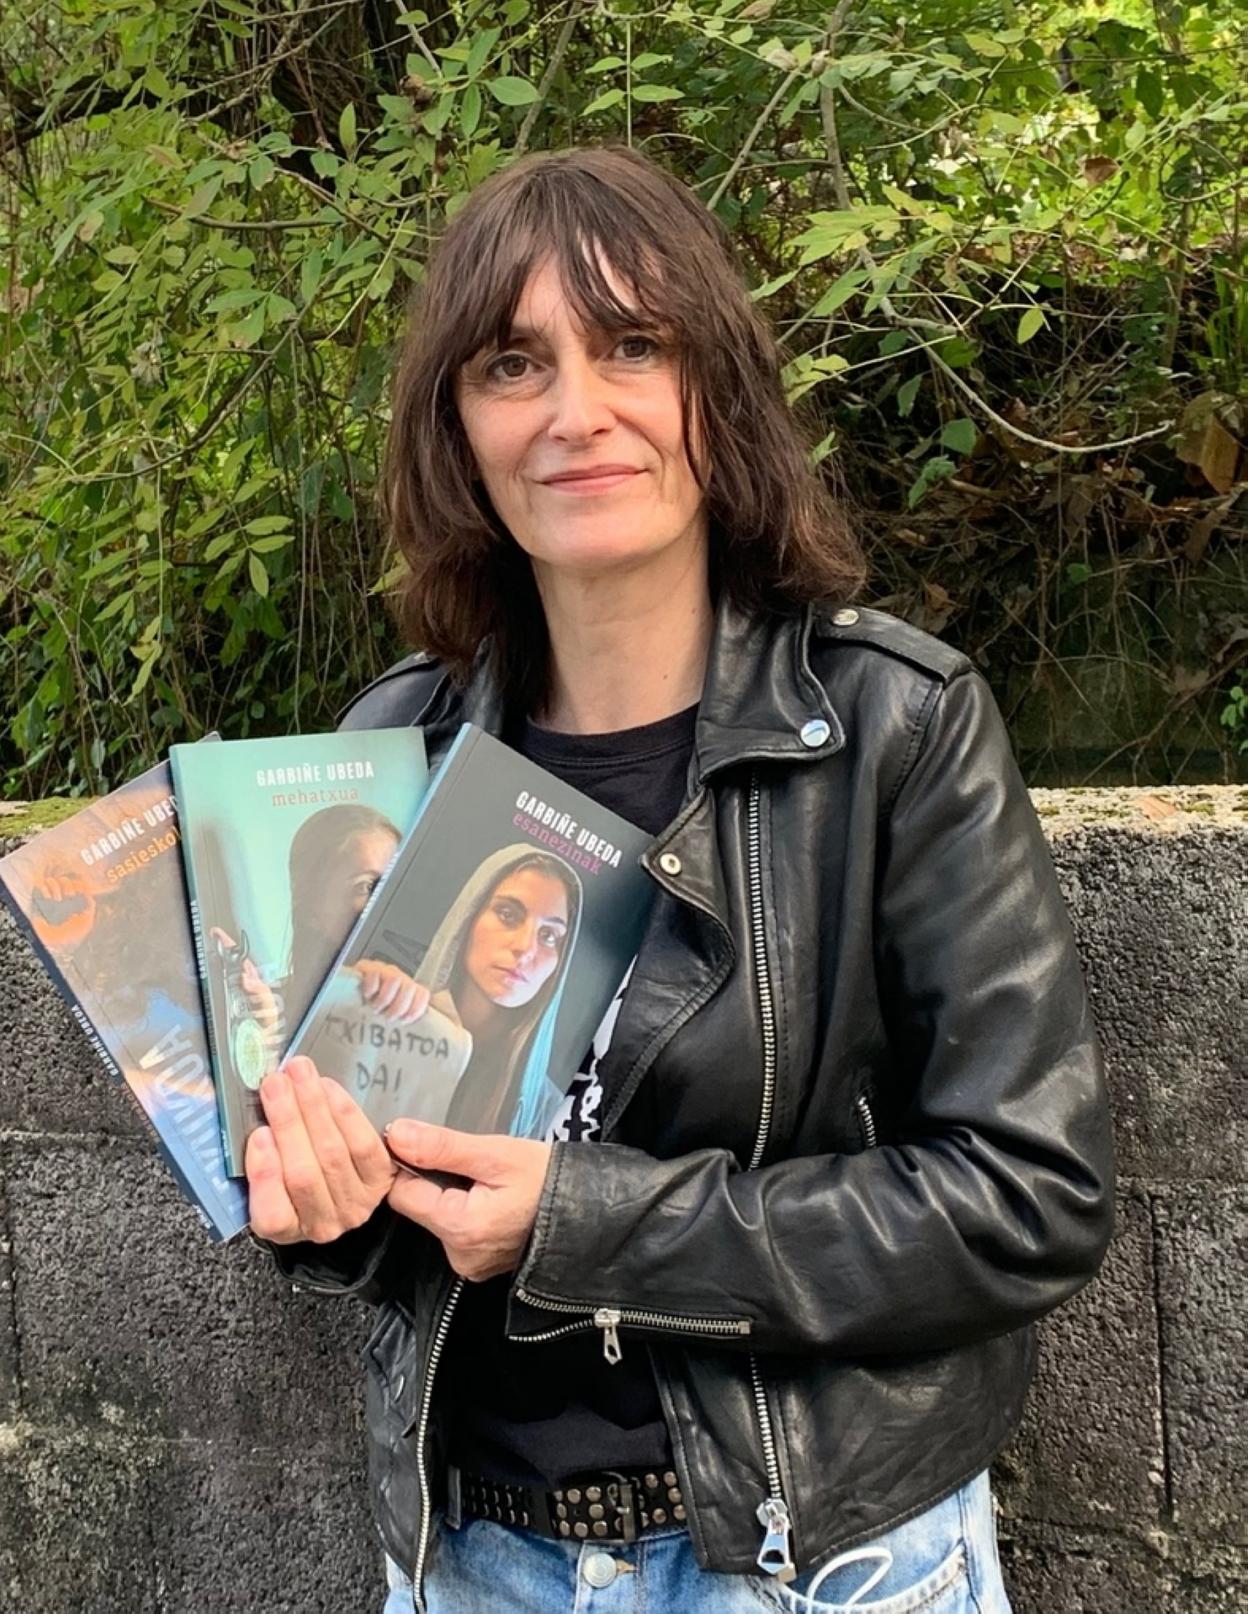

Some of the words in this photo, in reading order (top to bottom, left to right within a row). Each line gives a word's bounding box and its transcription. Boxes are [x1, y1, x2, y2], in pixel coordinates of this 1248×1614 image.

[256, 762, 321, 787] GARBIÑE
[326, 760, 375, 782] UBEDA
[271, 787, 359, 807] mehatxua
[80, 816, 146, 866] GARBIÑE
[512, 812, 602, 876] esanezinak
[515, 790, 578, 840] GARBIÑE
[576, 828, 622, 869] UBEDA
[325, 1012, 450, 1060] TXIBATOA
[356, 1061, 403, 1101] DA!
